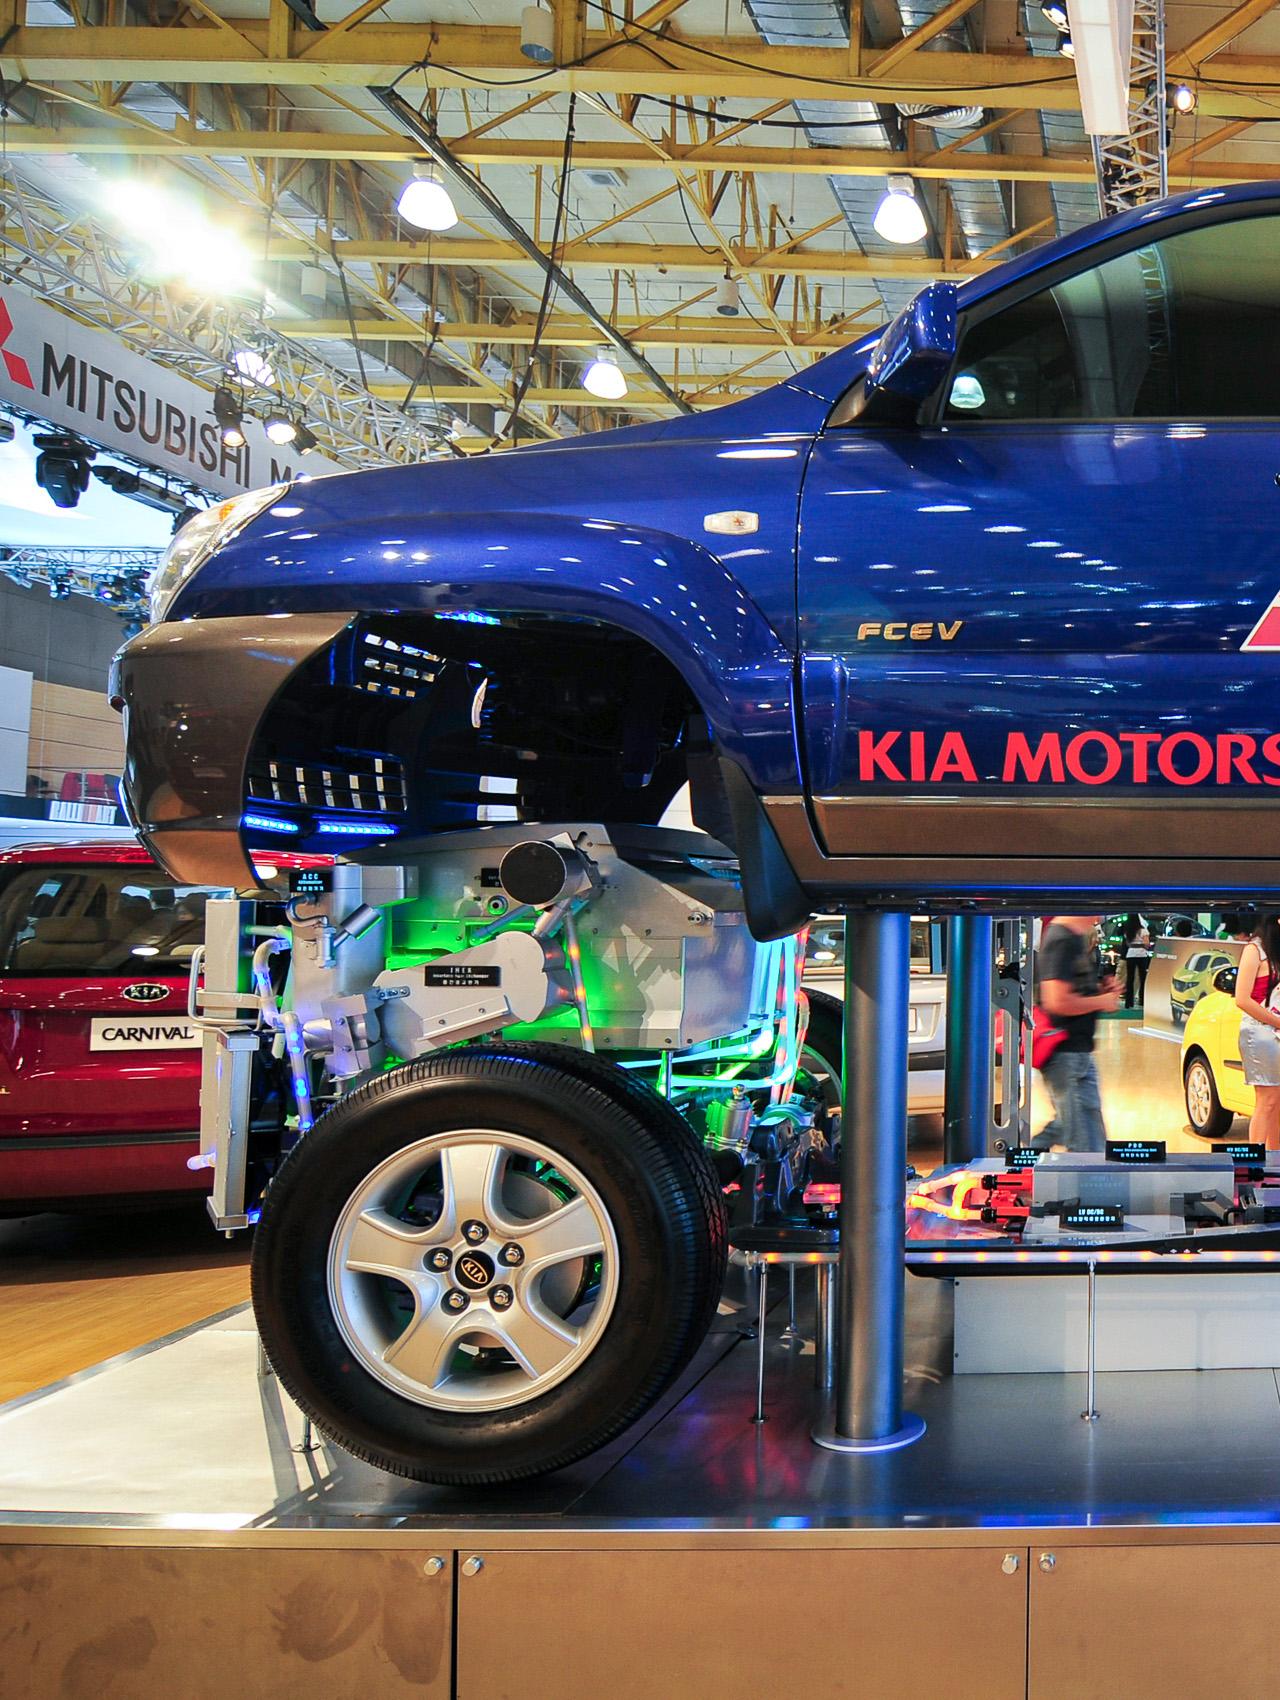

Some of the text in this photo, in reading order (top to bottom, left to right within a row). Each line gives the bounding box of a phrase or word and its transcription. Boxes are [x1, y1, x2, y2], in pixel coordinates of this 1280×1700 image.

[41, 342, 251, 489] MITSUBISHI
[857, 620, 964, 641] FCEV
[858, 730, 978, 783] KIA
[130, 986, 161, 998] KIA
[101, 1026, 195, 1042] CARNIVAL
[464, 1261, 484, 1282] KIA
